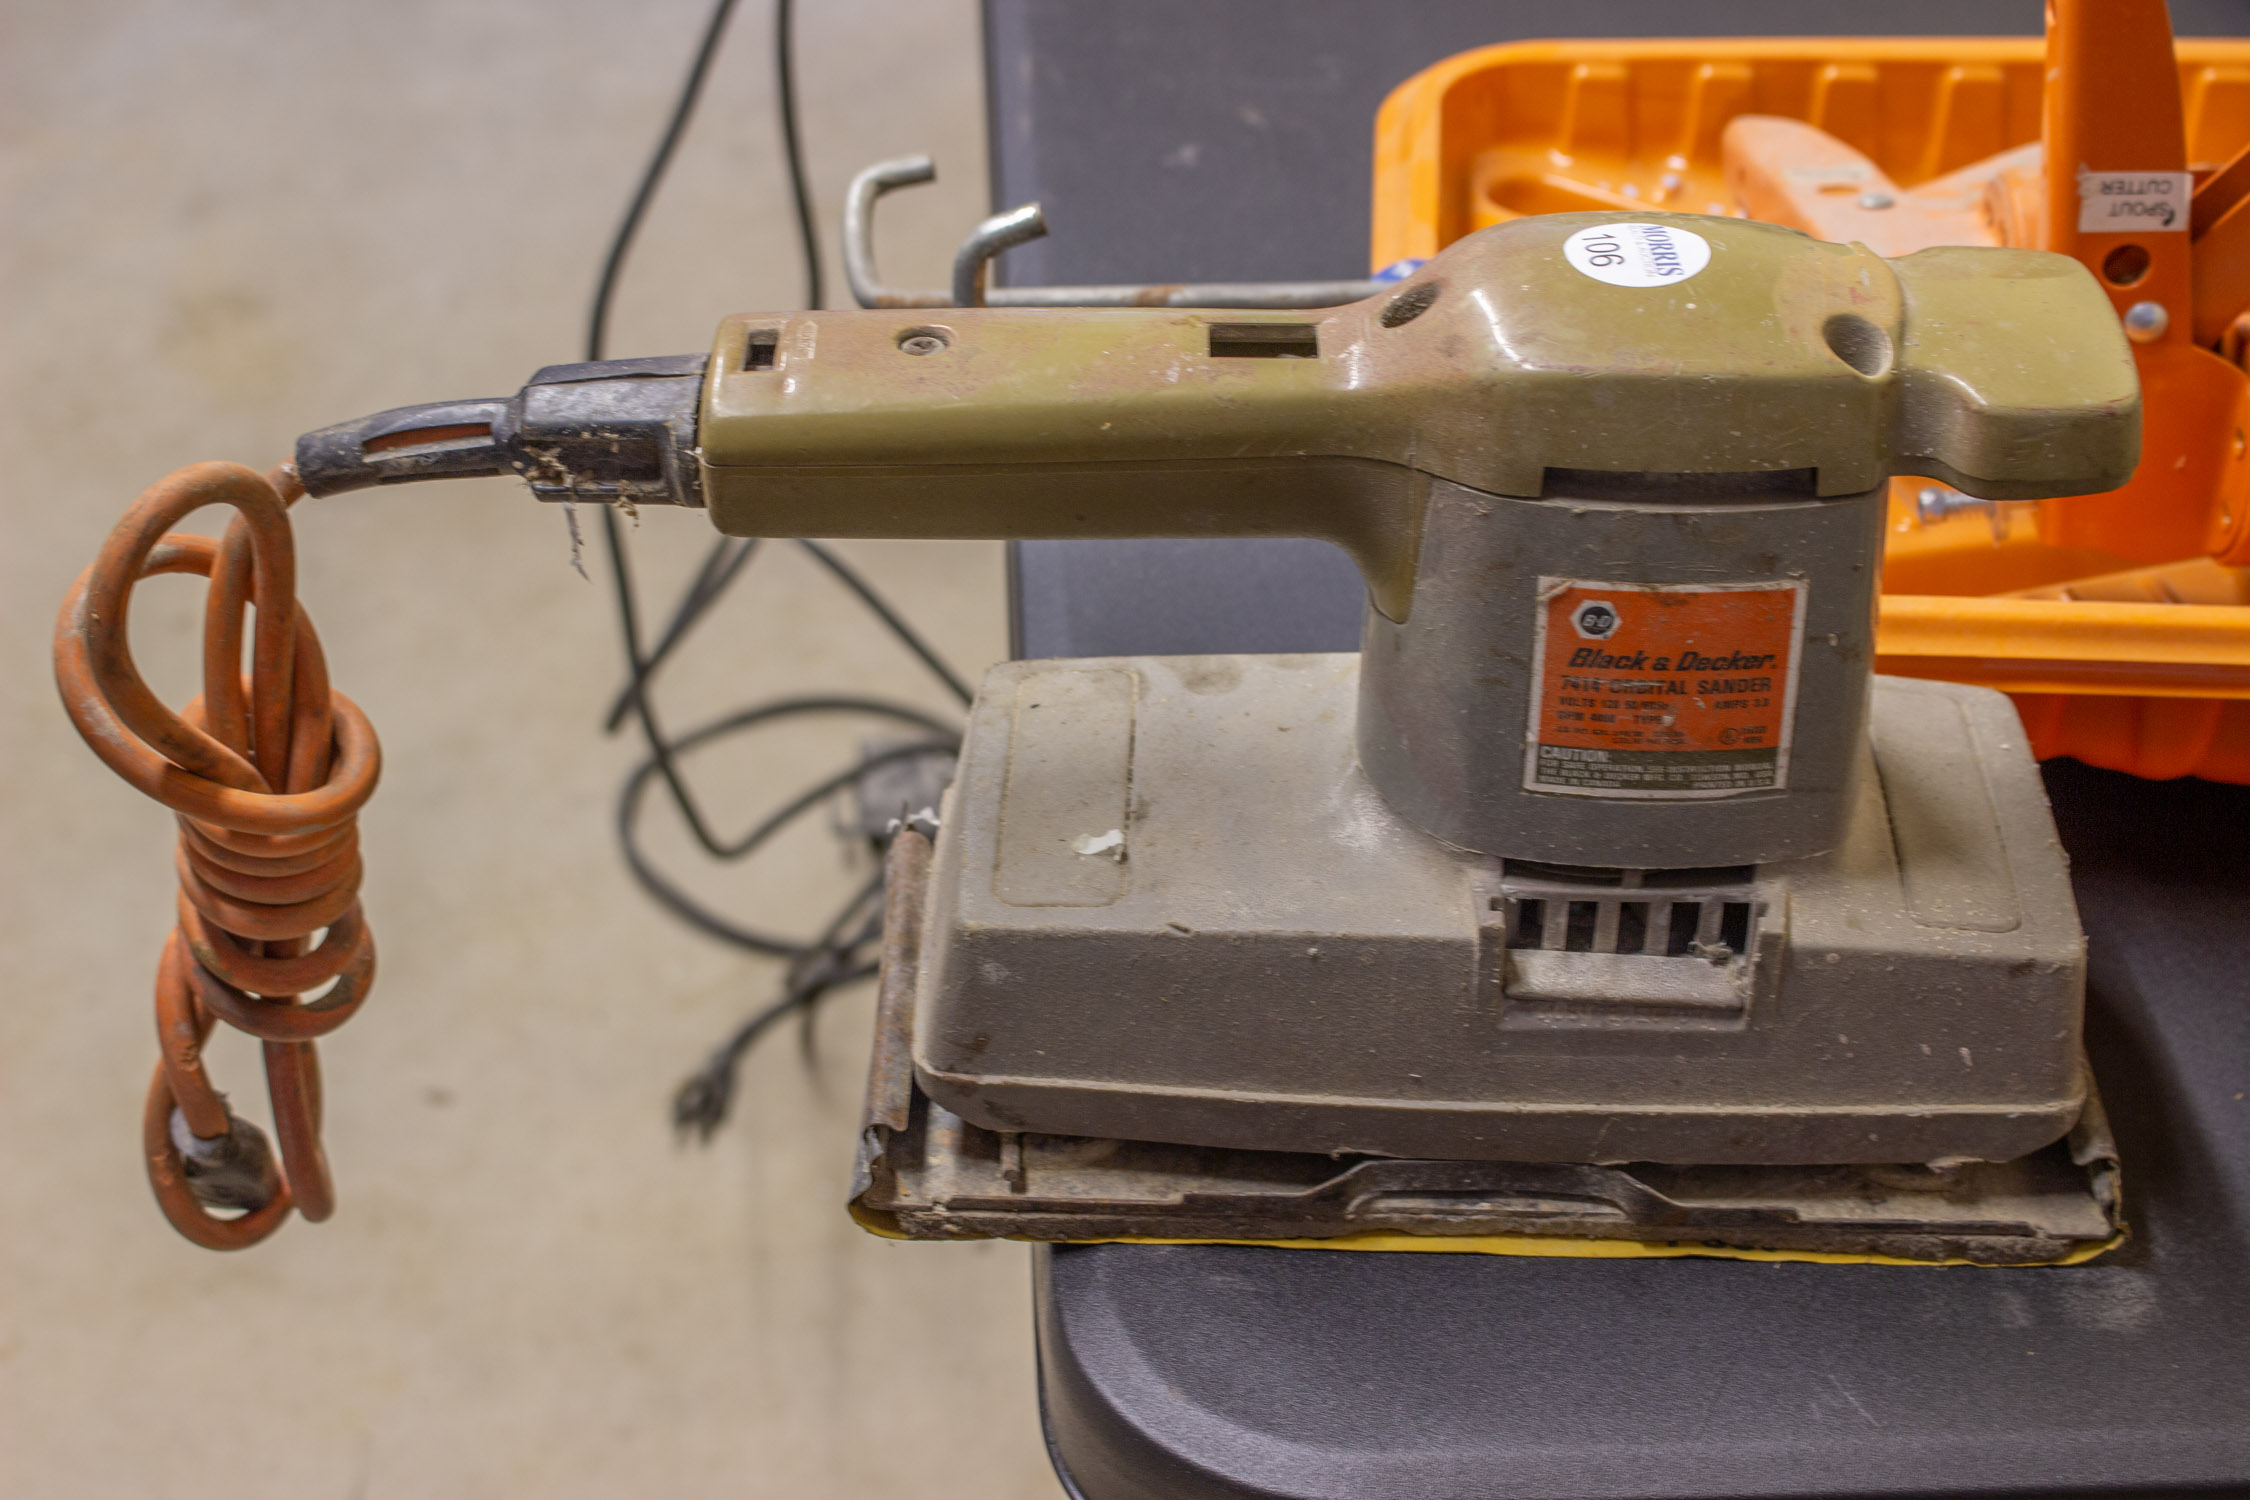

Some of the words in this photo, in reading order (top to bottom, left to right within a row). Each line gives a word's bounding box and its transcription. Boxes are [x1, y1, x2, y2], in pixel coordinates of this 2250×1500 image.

[2101, 179, 2172, 195] CUTTER
[2107, 201, 2171, 217] SPOUT
[1582, 233, 1625, 267] 106
[1640, 226, 1684, 276] MORRIS
[1568, 647, 1649, 671] Black
[1652, 656, 1670, 671] &
[1675, 650, 1776, 672] Decker
[1609, 678, 1688, 695] ORBITAL
[1697, 677, 1772, 695] SANDER
